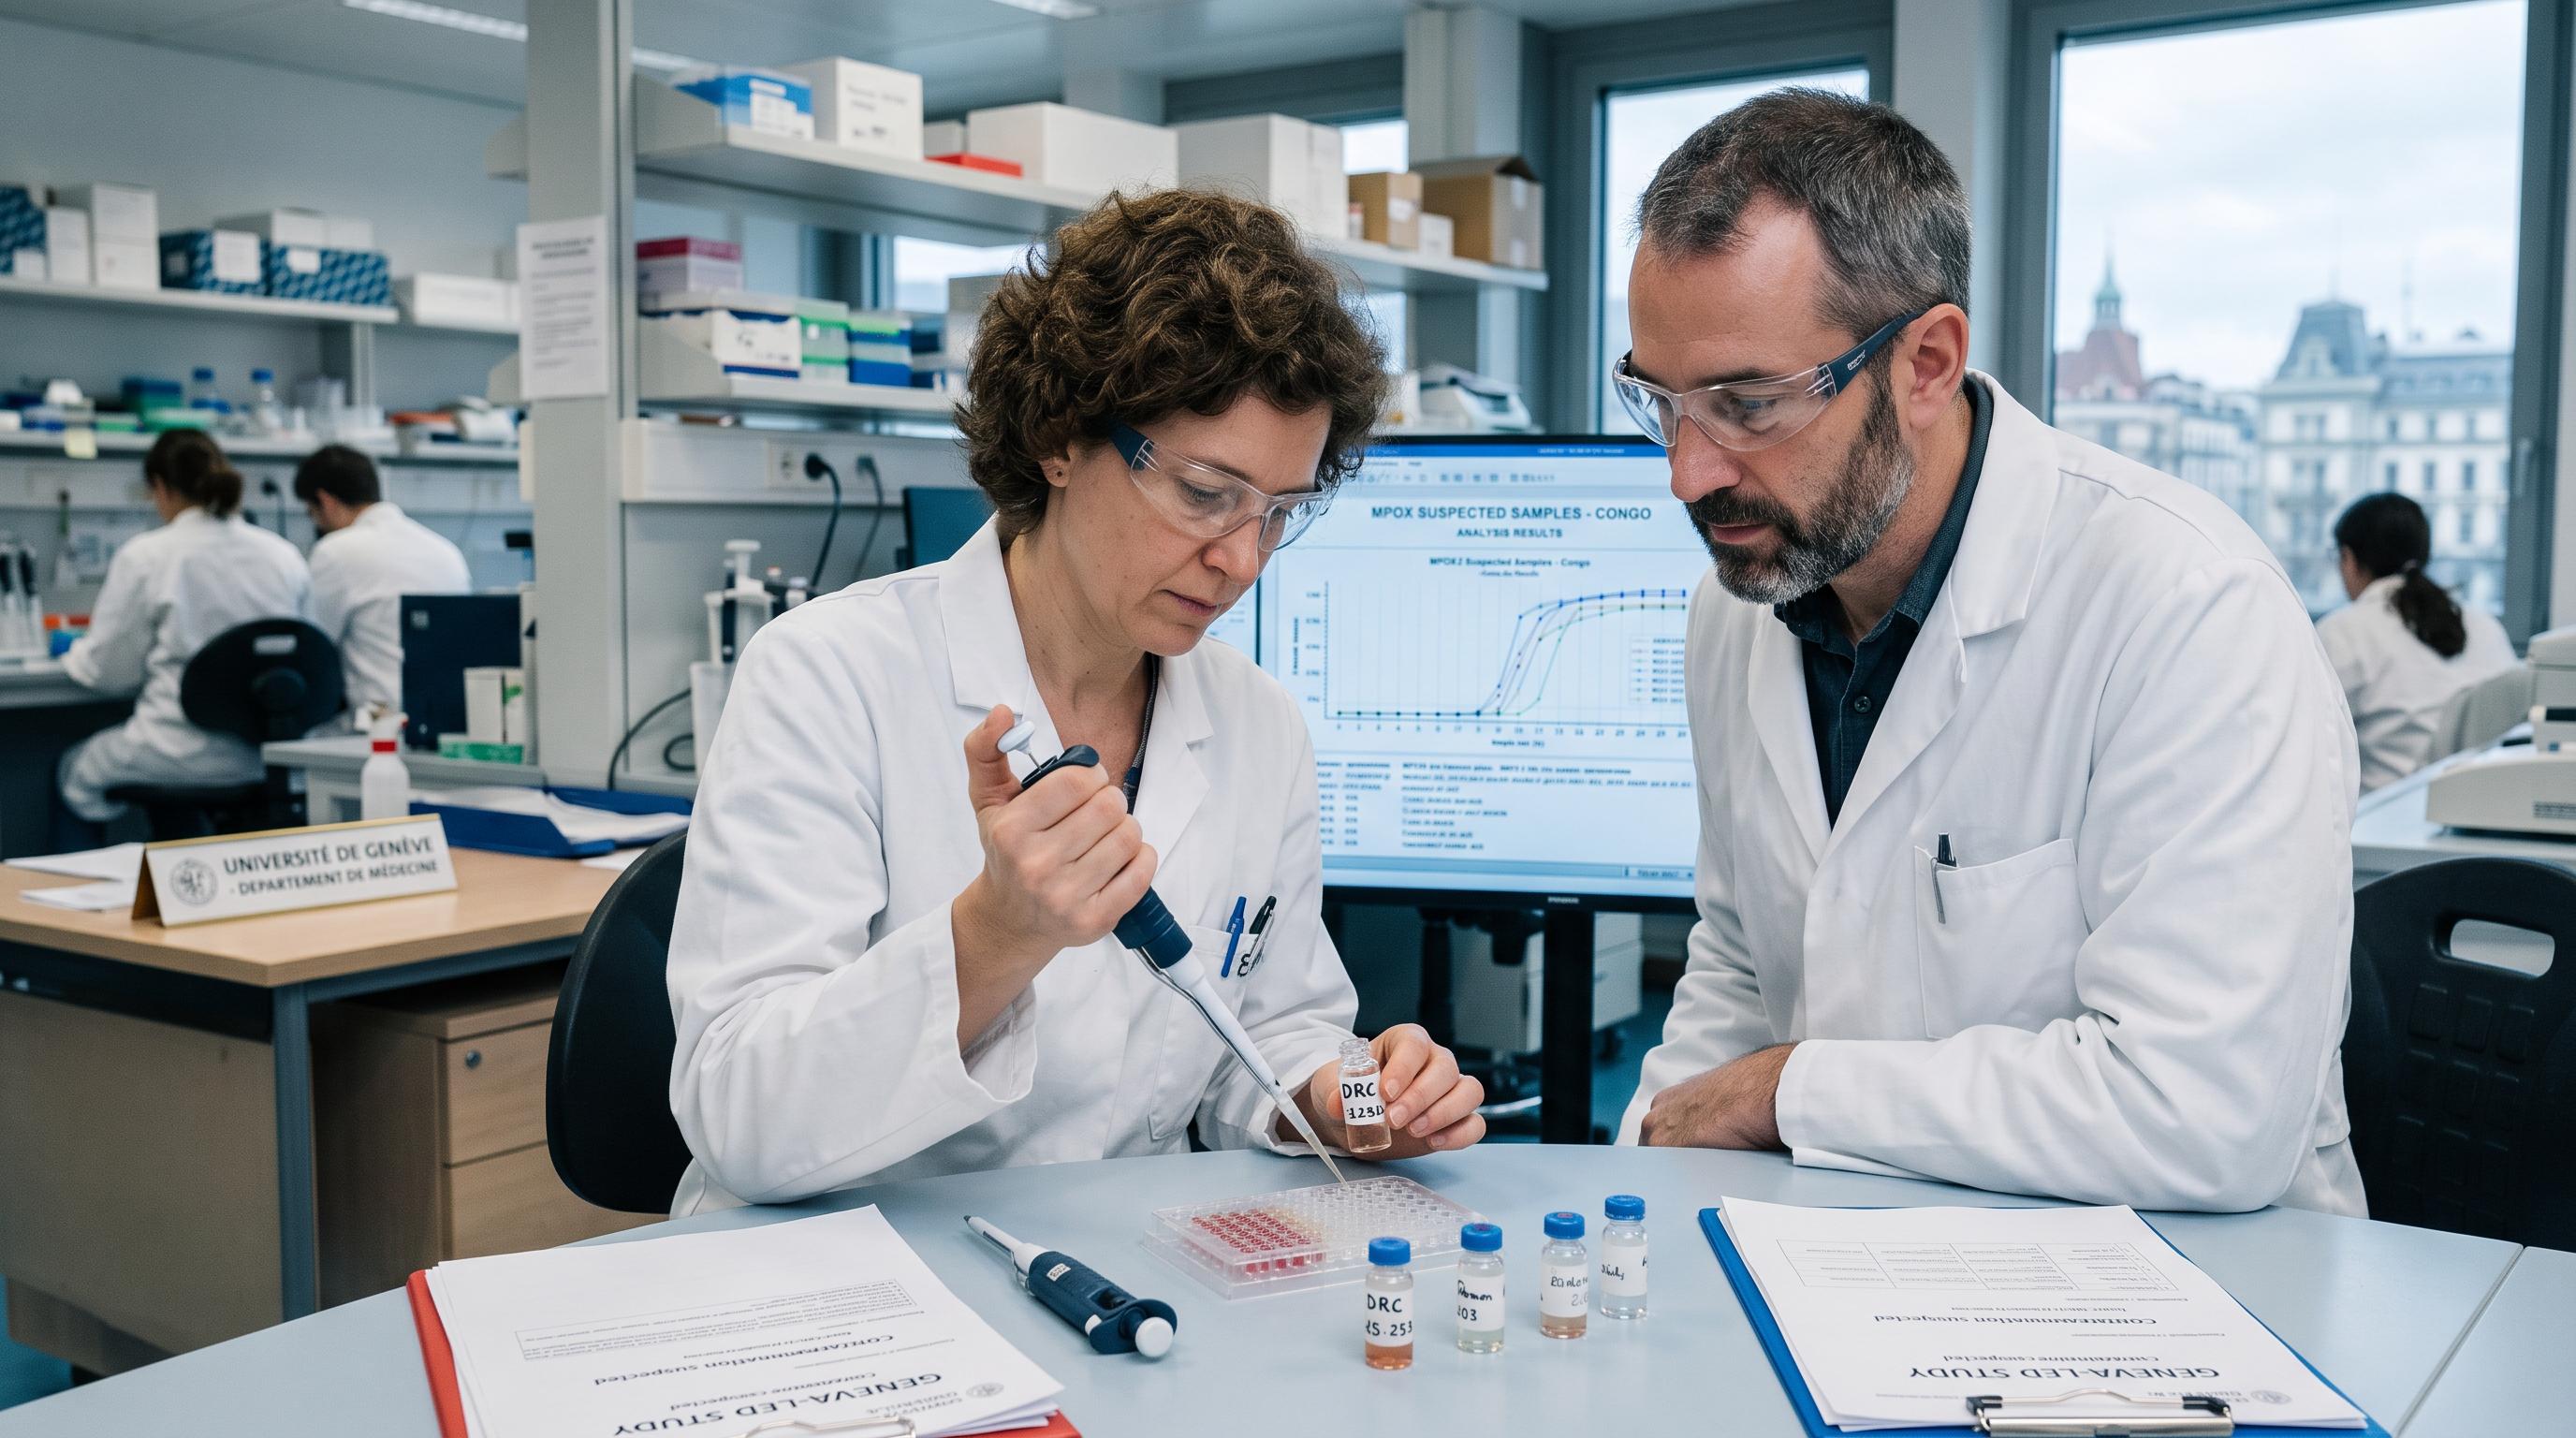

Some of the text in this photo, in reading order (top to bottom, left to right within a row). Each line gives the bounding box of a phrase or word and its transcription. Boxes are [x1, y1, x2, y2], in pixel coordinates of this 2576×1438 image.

[1371, 506, 1413, 520] MPOX
[1418, 506, 1506, 520] SUSPECTED
[1511, 506, 1581, 520] SAMPLES
[1595, 507, 1651, 521] CONGO
[1456, 528, 1563, 538] ANALYSIS RESULTS
[223, 836, 432, 875] UNIVERSITÉ DE GENÈVE
[347, 868, 364, 883] DE
[369, 859, 438, 879] MÉDECINE
[1341, 1082, 1376, 1099] DRC
[1367, 1294, 1402, 1313] DRC
[1910, 1367, 2220, 1380] GENEVA-LED STUDY
[736, 1372, 943, 1416] GENEVA-LED
[613, 1410, 724, 1437] STUDY
